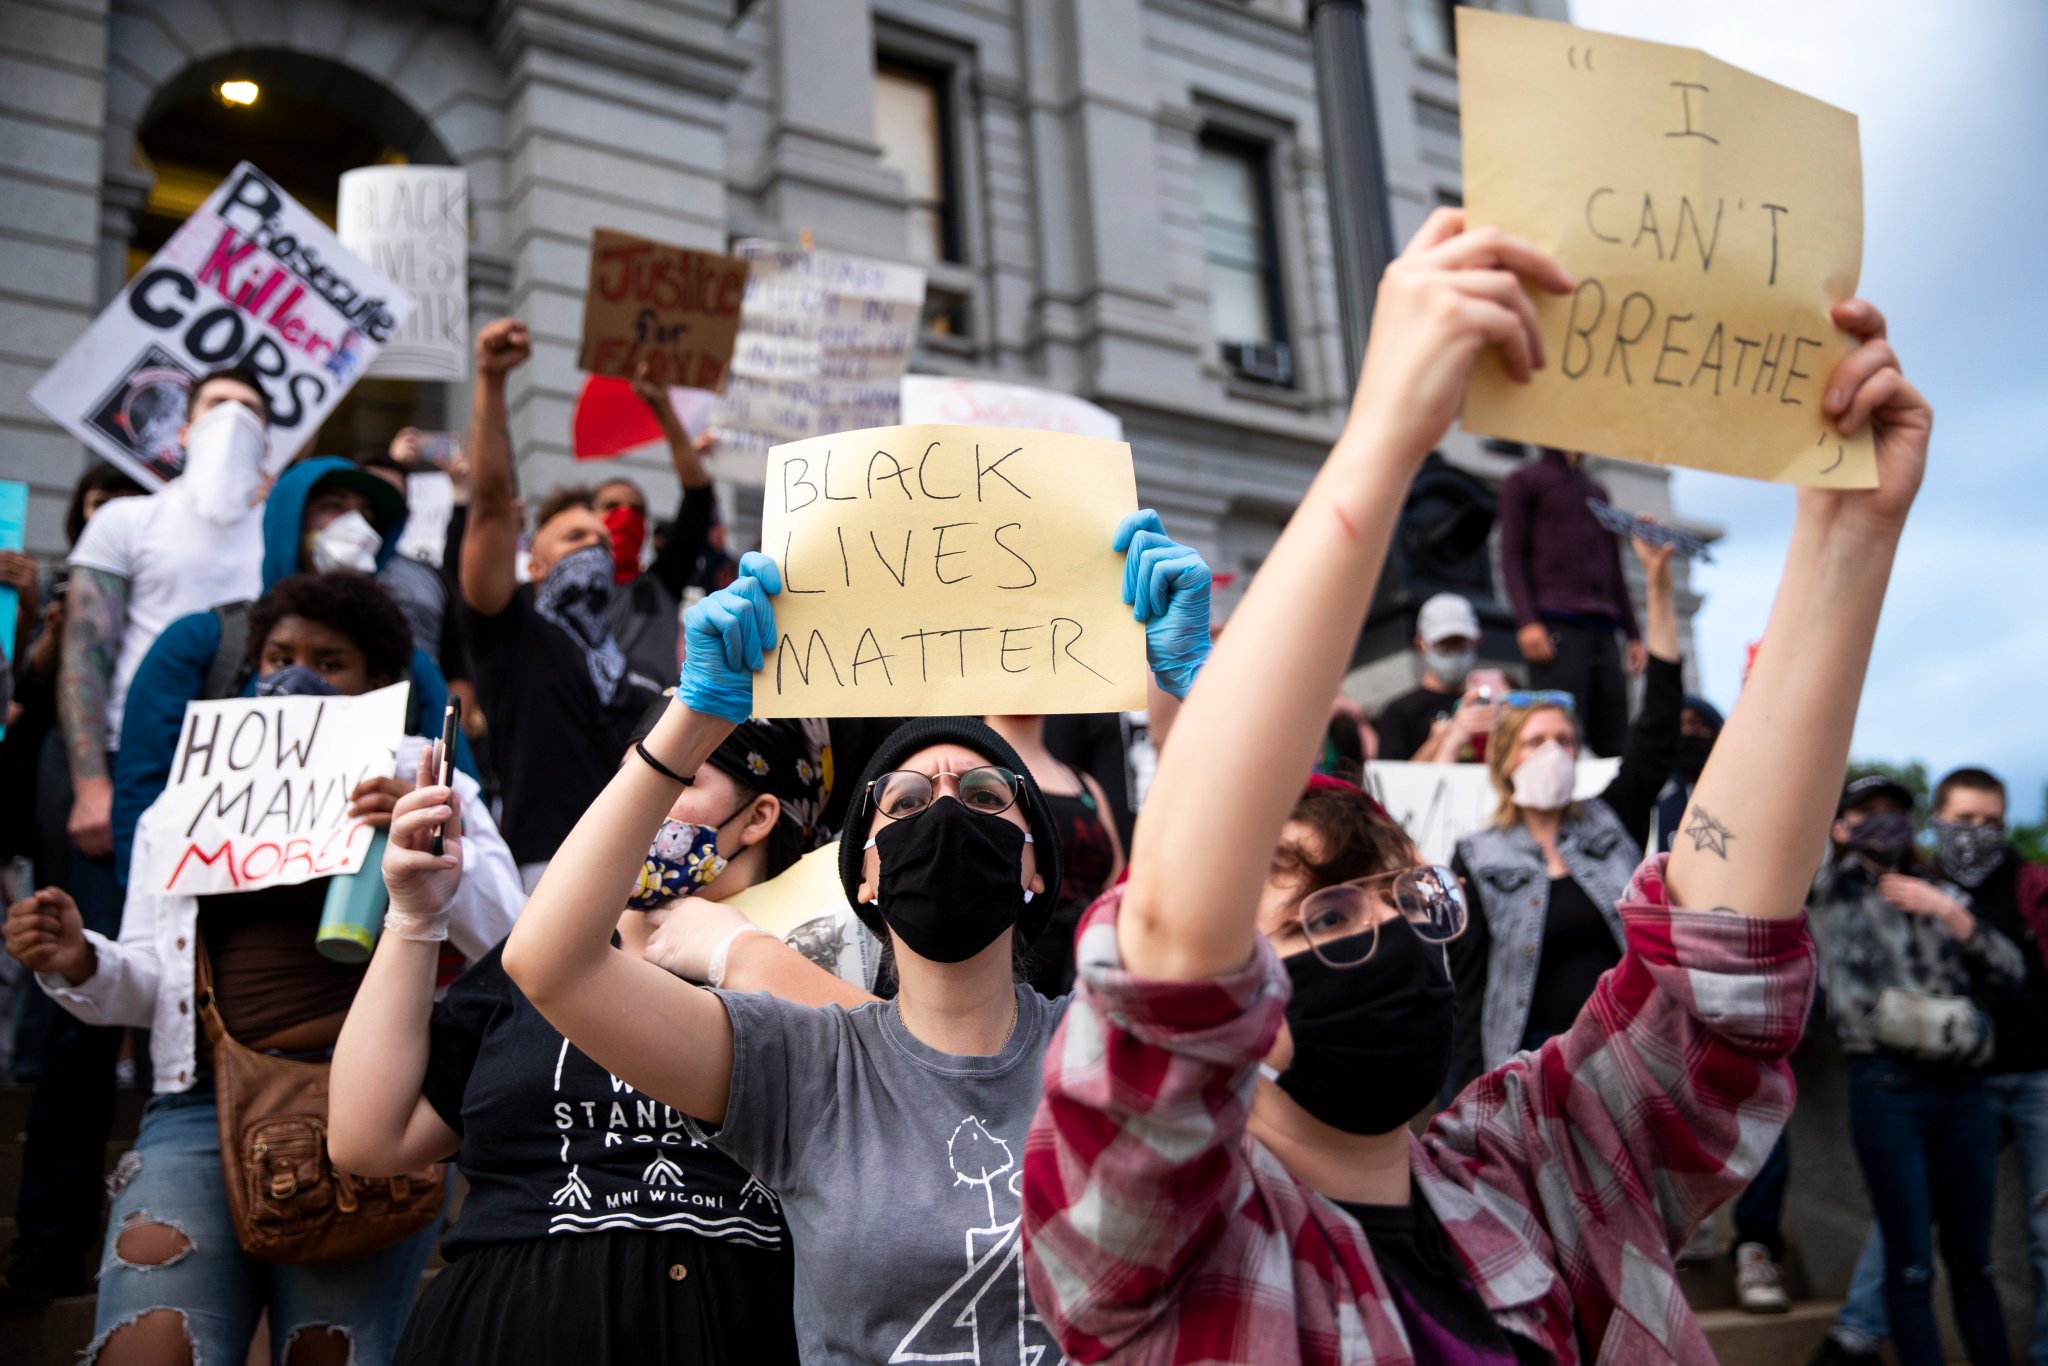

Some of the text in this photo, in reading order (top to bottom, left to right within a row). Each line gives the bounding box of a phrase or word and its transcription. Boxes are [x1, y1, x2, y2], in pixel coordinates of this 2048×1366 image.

[1665, 81, 1720, 145] I
[1585, 187, 1789, 286] CAN'T
[197, 227, 335, 357] Killer
[128, 268, 325, 428] COPS
[1561, 277, 1822, 405] BREATHE
[783, 441, 1032, 513] BLACK
[783, 521, 1038, 594] LIVES
[777, 616, 1119, 696] MATTER
[177, 701, 325, 785] HOW
[186, 763, 369, 837] MANY
[605, 1189, 724, 1209] MNI WICONI
